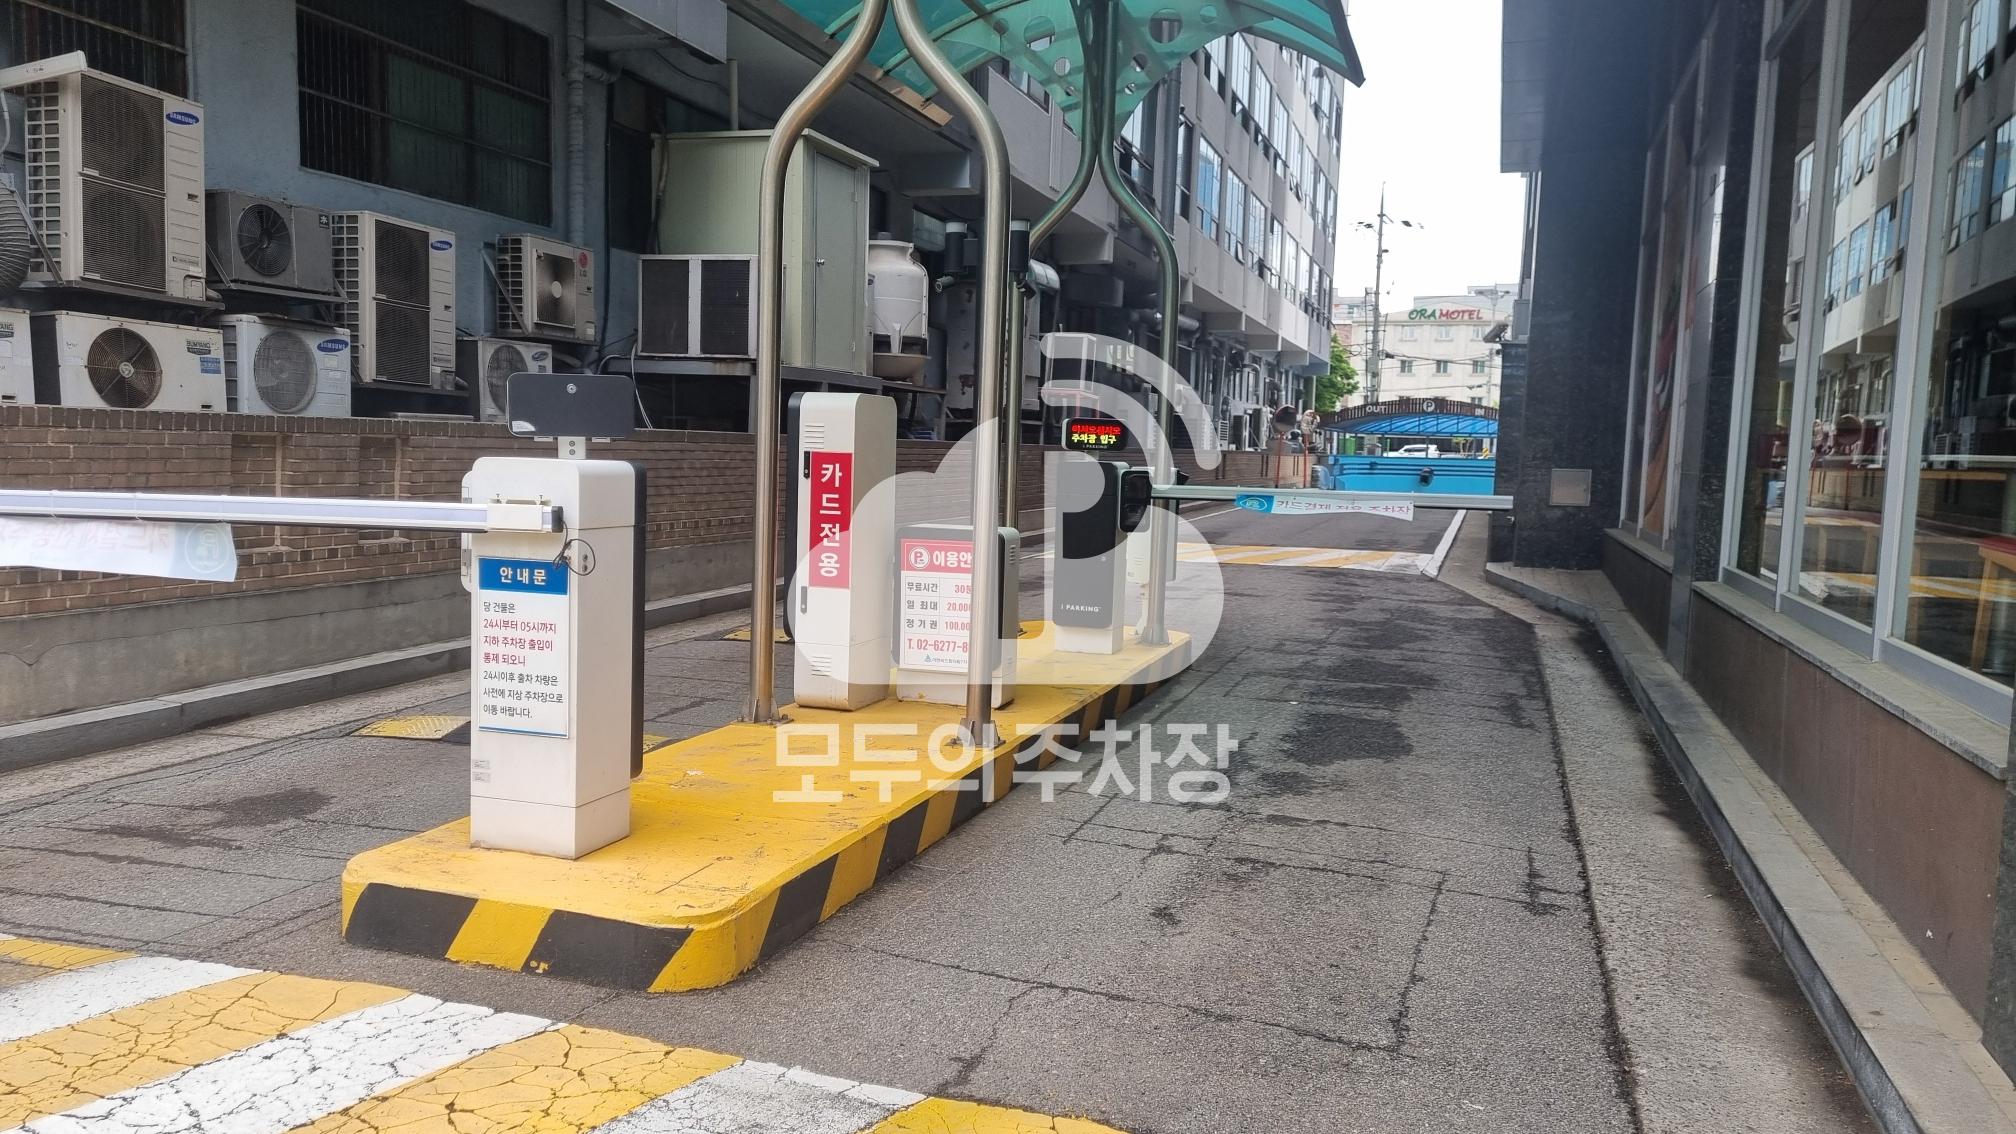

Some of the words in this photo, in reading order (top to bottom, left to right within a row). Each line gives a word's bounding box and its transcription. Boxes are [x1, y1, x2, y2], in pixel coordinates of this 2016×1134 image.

[1408, 308, 1437, 320] ORA
[1438, 309, 1483, 320] MOTEL
[1366, 405, 1386, 413] OUT
[1475, 408, 1485, 416] IN
[932, 551, 972, 567] 이용안
[907, 582, 938, 592] 무료시간
[483, 602, 491, 612] 당
[493, 602, 516, 613] 건물은
[1066, 604, 1099, 612] PARKING
[483, 619, 518, 631] 24시부터
[520, 621, 556, 634] 05시까지
[483, 636, 499, 647] 지하
[501, 637, 526, 649] 주차장
[528, 639, 553, 652] 출입이
[917, 639, 968, 653] 02-6277-8
[483, 652, 499, 664] 통제
[502, 654, 526, 666] 되오니
[483, 671, 516, 683] 24시이후
[518, 673, 533, 684] 출차
[535, 674, 559, 686] 차량은
[483, 687, 506, 698] 사전에
[507, 689, 523, 700] 지상
[524, 690, 564, 703] 주차장으로
[483, 704, 498, 715] 이동
[500, 705, 533, 718] 바랍니다.
